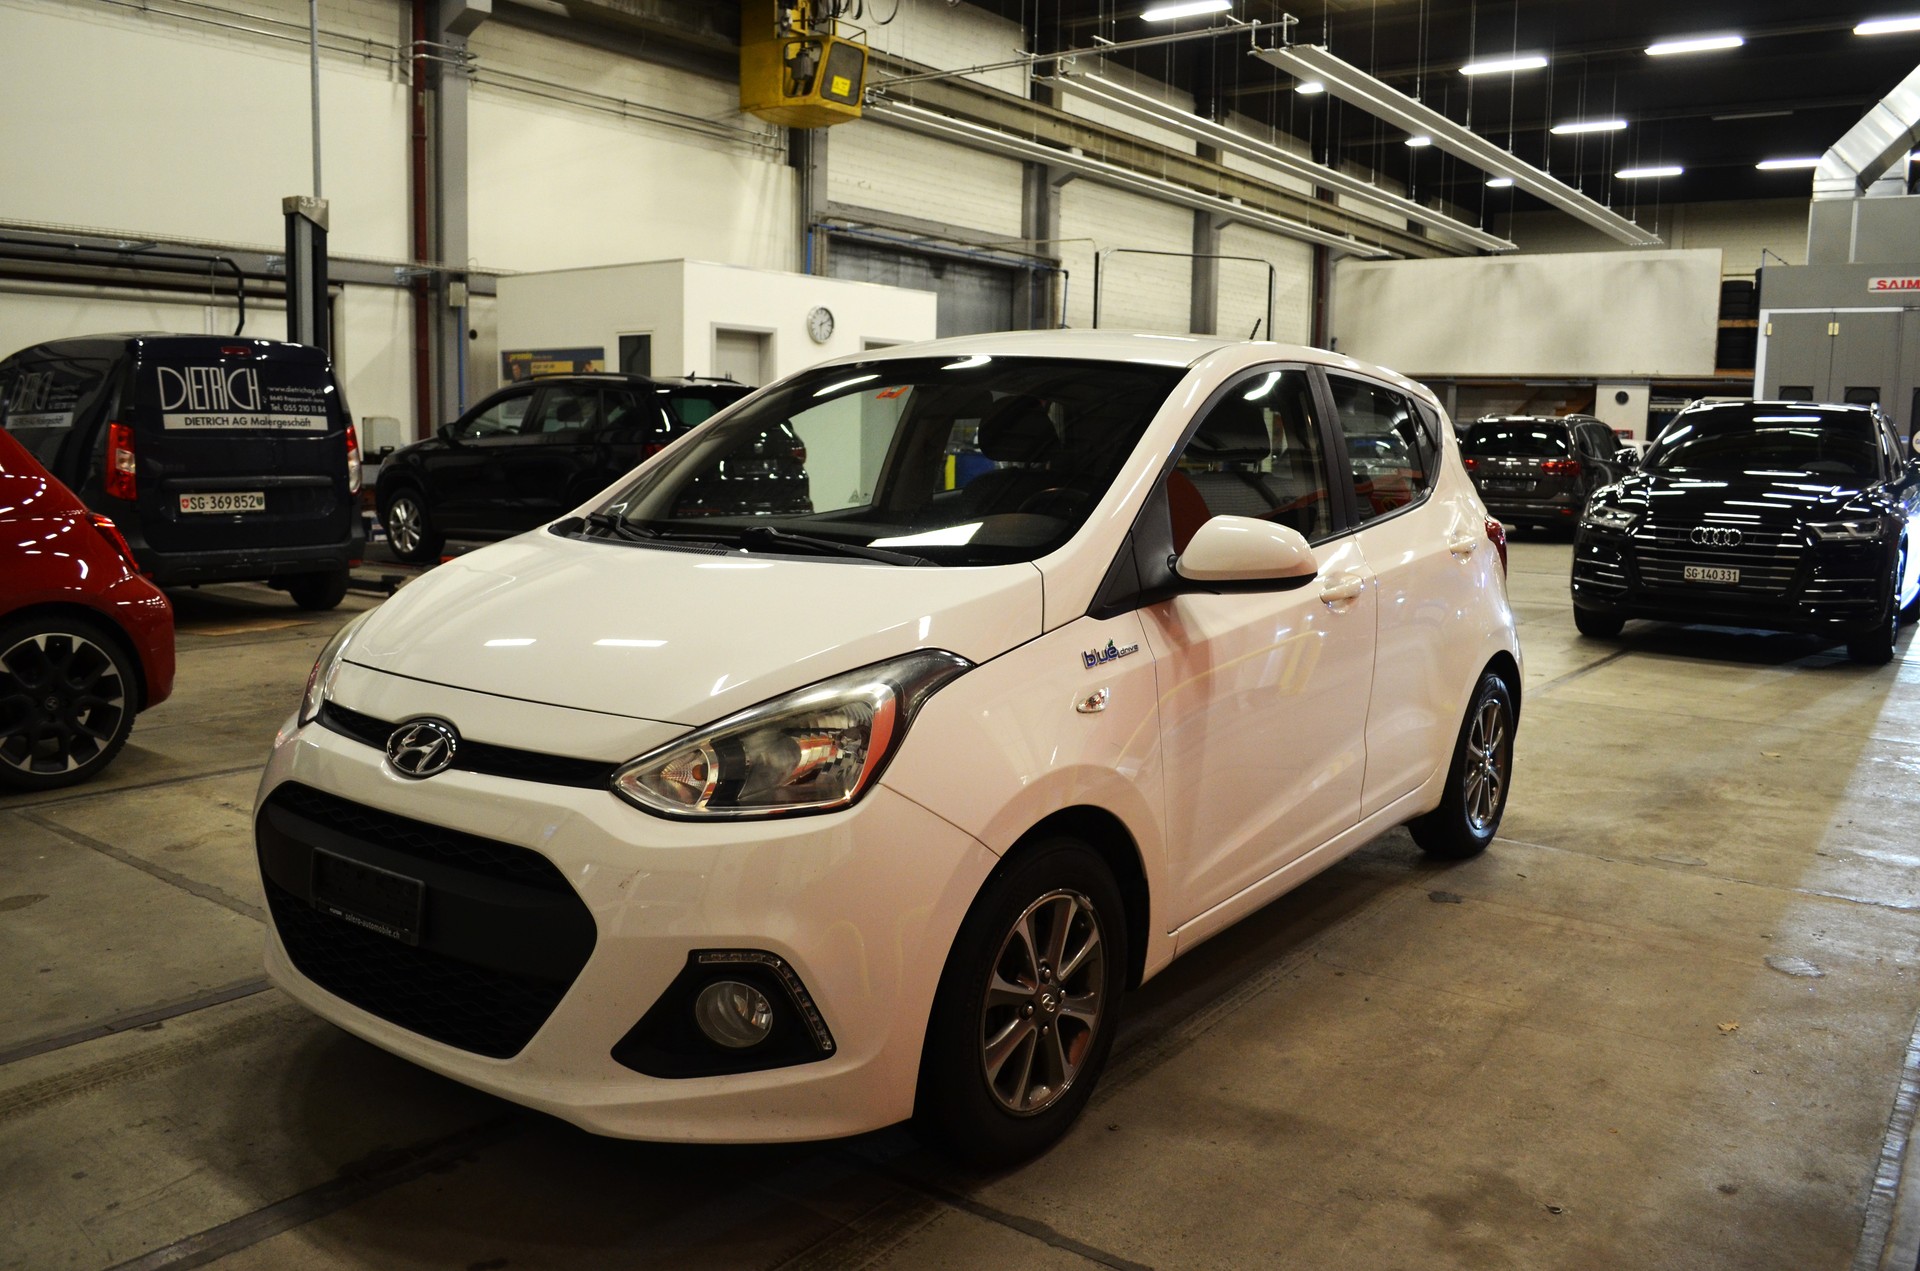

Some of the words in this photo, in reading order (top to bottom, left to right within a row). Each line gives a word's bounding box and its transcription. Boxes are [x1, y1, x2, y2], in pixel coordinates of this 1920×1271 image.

[157, 366, 261, 411] DIETRICH
[270, 403, 282, 411] Tel.
[283, 404, 297, 412] 055
[298, 404, 310, 412] 210
[184, 417, 229, 426] DIETRICH
[232, 417, 248, 426] AG
[250, 416, 311, 428] Malergeschäft
